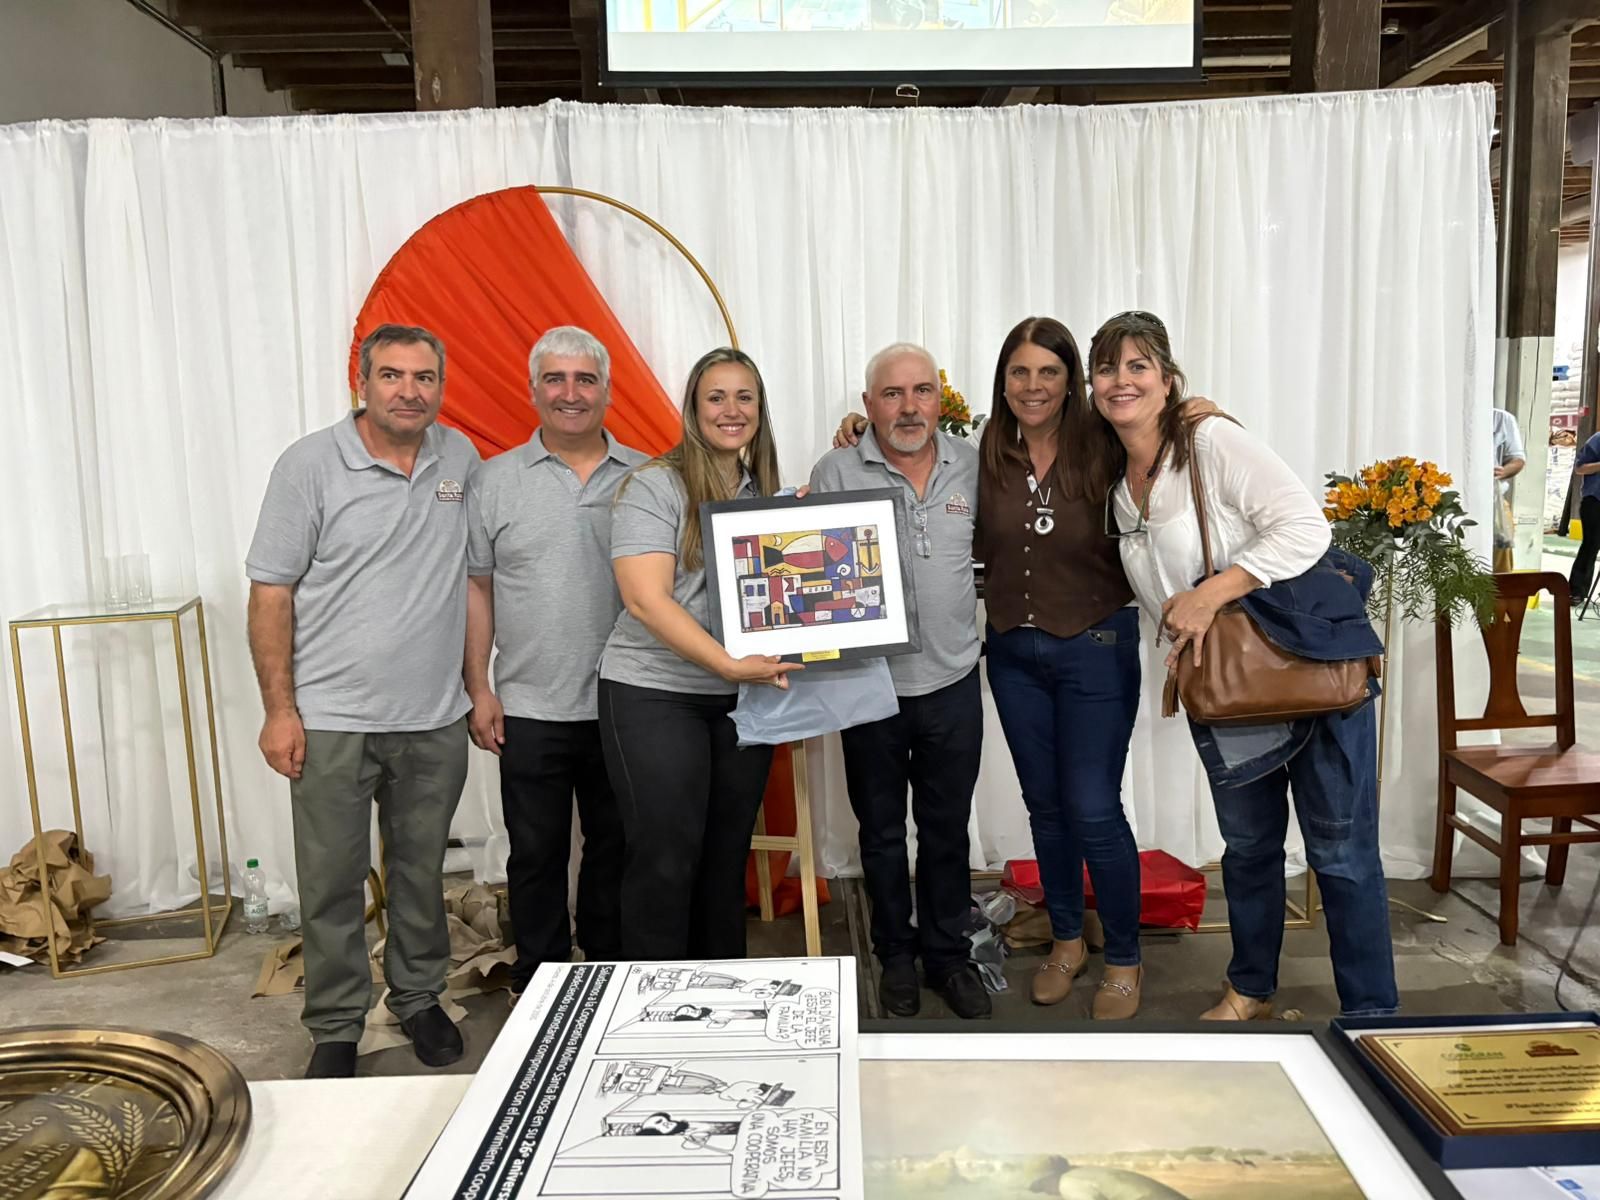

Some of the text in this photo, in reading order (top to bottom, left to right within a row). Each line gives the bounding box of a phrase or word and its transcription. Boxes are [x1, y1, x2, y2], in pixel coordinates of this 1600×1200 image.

[561, 966, 587, 1004] agradeciendo
[590, 966, 612, 996] Saludamos
[558, 1004, 569, 1013] su
[819, 991, 832, 1009] BUEN
[541, 1012, 565, 1044] constante
[567, 1008, 594, 1046] Cooperativa
[776, 1006, 791, 1040] FAMILIA?
[790, 1010, 805, 1034] DE LA
[805, 1016, 817, 1024] EL
[804, 1026, 817, 1044] JEFE
[520, 1044, 549, 1090] compromiso
[556, 1046, 578, 1071] Molino
[546, 1072, 567, 1094] Santa
[506, 1106, 520, 1115] el
[511, 1090, 527, 1106] con
[536, 1095, 556, 1114] Rosa
[525, 1128, 538, 1139] su
[530, 1115, 544, 1127] en
[478, 1116, 514, 1172] movimiento
[741, 1113, 765, 1194] UNA COOPERATIVA
[762, 1126, 780, 1165] SOMOS
[773, 1119, 798, 1182] HAY JEFES,
[797, 1112, 814, 1181] FAMILIA NO
[814, 1121, 829, 1168] EN ESTA
